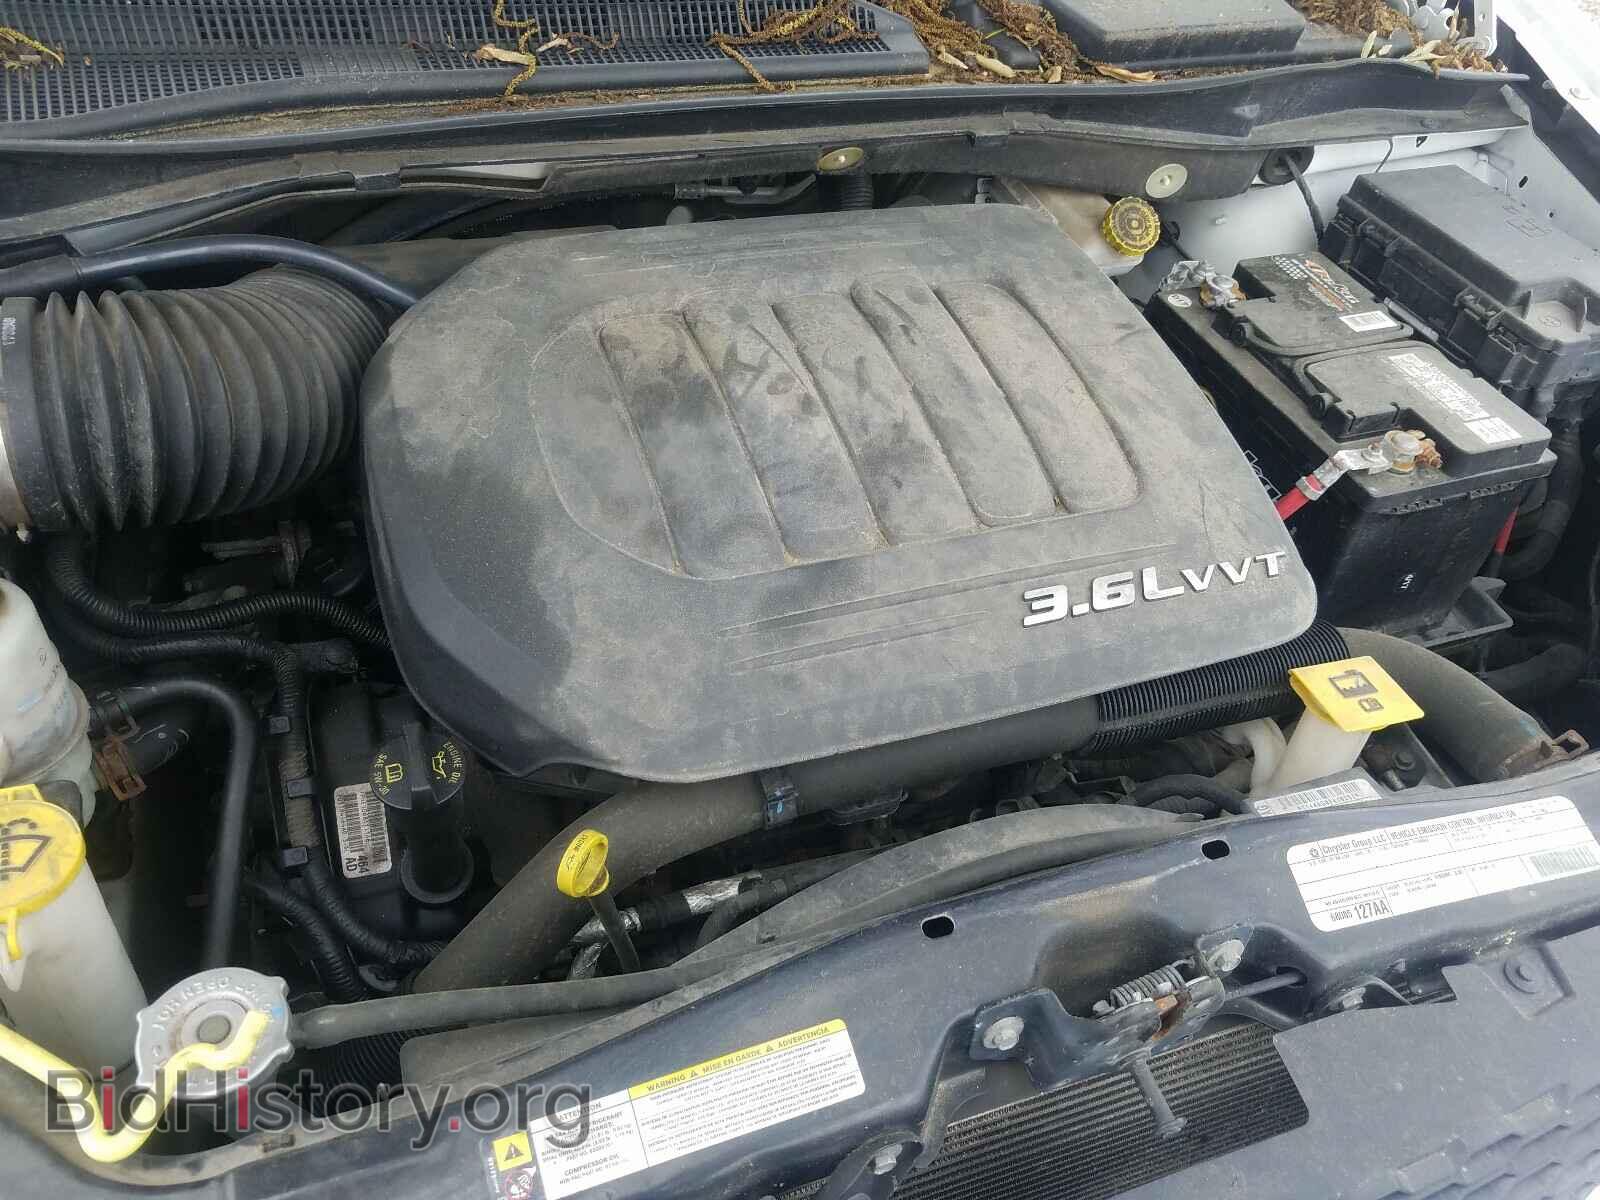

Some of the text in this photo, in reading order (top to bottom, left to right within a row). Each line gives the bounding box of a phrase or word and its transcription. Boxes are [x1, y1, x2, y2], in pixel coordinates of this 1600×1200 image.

[1023, 551, 1286, 628] 3.6L VVT
[374, 753, 388, 768] SAE
[443, 741, 463, 784] ENGINE OIL
[1323, 841, 1351, 858] Chrysler
[1352, 836, 1373, 849] Group
[1373, 831, 1387, 844] LLC
[1354, 899, 1389, 920] 127AA
[778, 1025, 830, 1049] ADVERTENCIA
[723, 1057, 734, 1067] EN
[647, 1074, 686, 1092] WARNING
